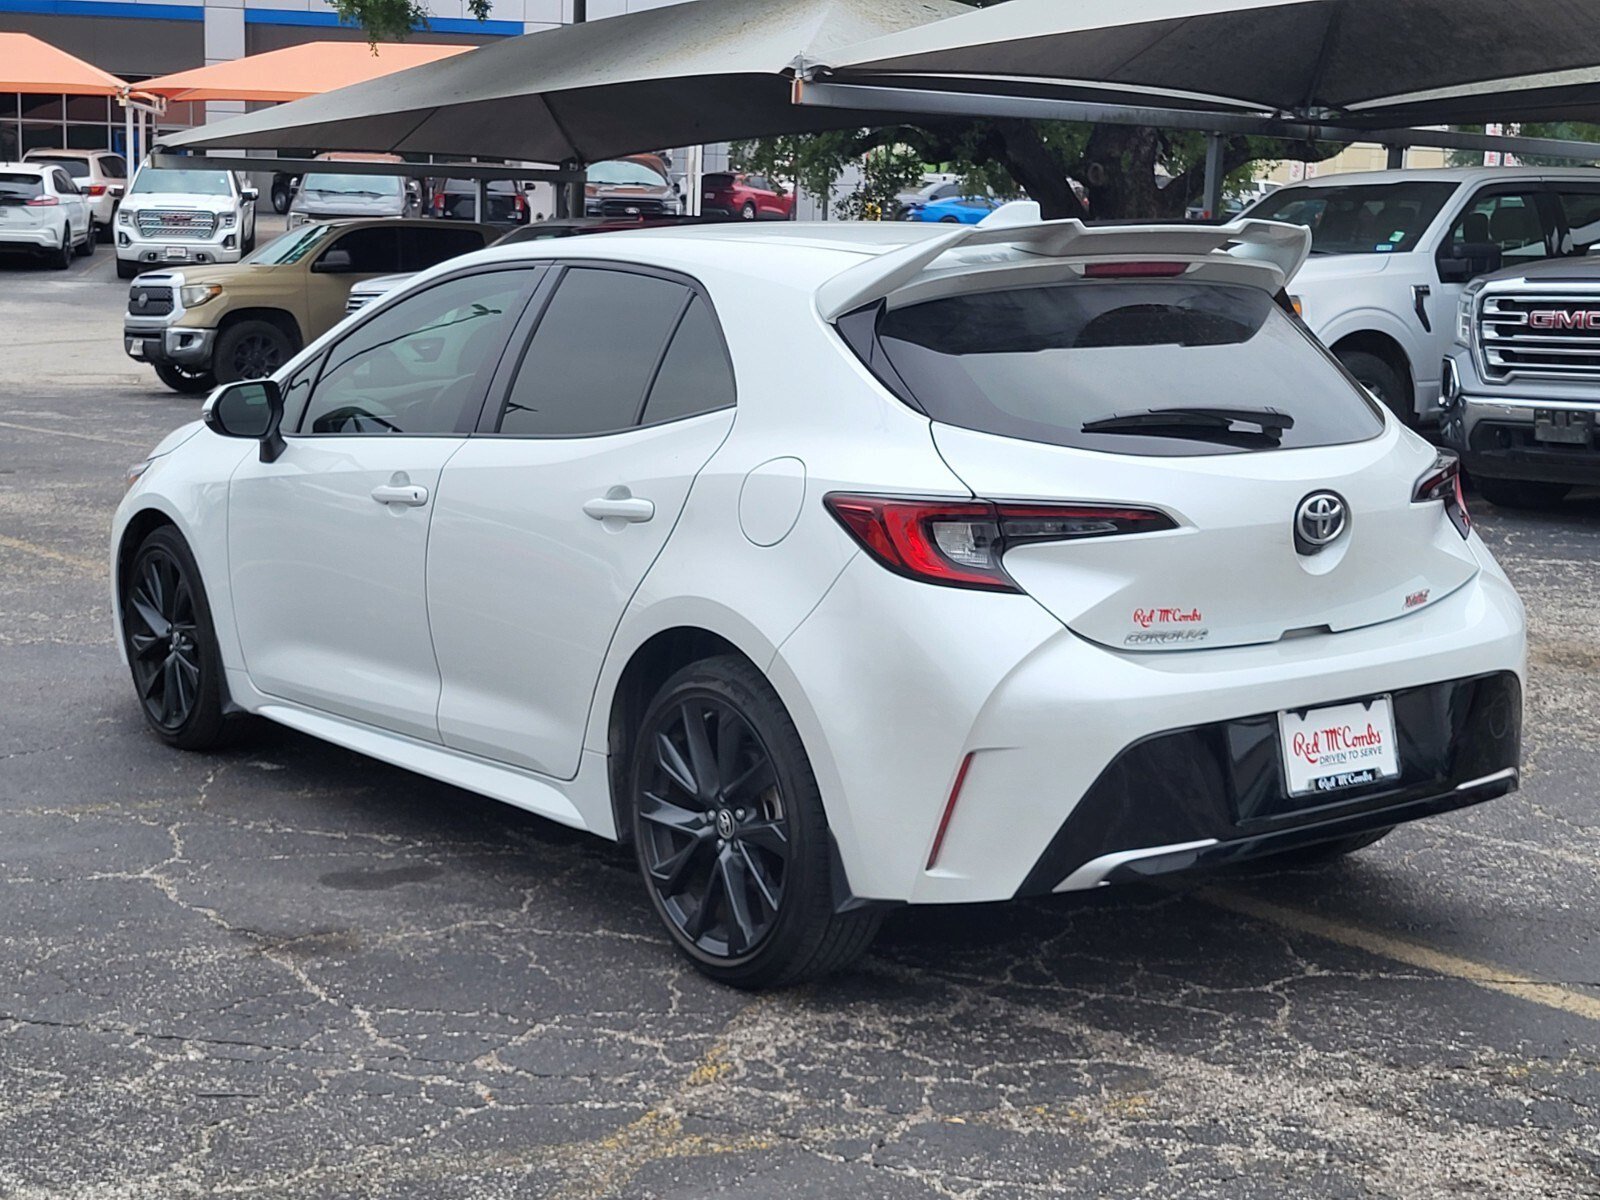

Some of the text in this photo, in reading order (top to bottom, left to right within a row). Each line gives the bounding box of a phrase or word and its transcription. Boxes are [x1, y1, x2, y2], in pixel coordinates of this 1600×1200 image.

[1529, 310, 1600, 329] GMC
[1133, 608, 1155, 628] Red
[1293, 723, 1381, 764] Red McCombs
[1319, 746, 1383, 765] DRIVEN TO SERVE
[1317, 776, 1336, 791] Red
